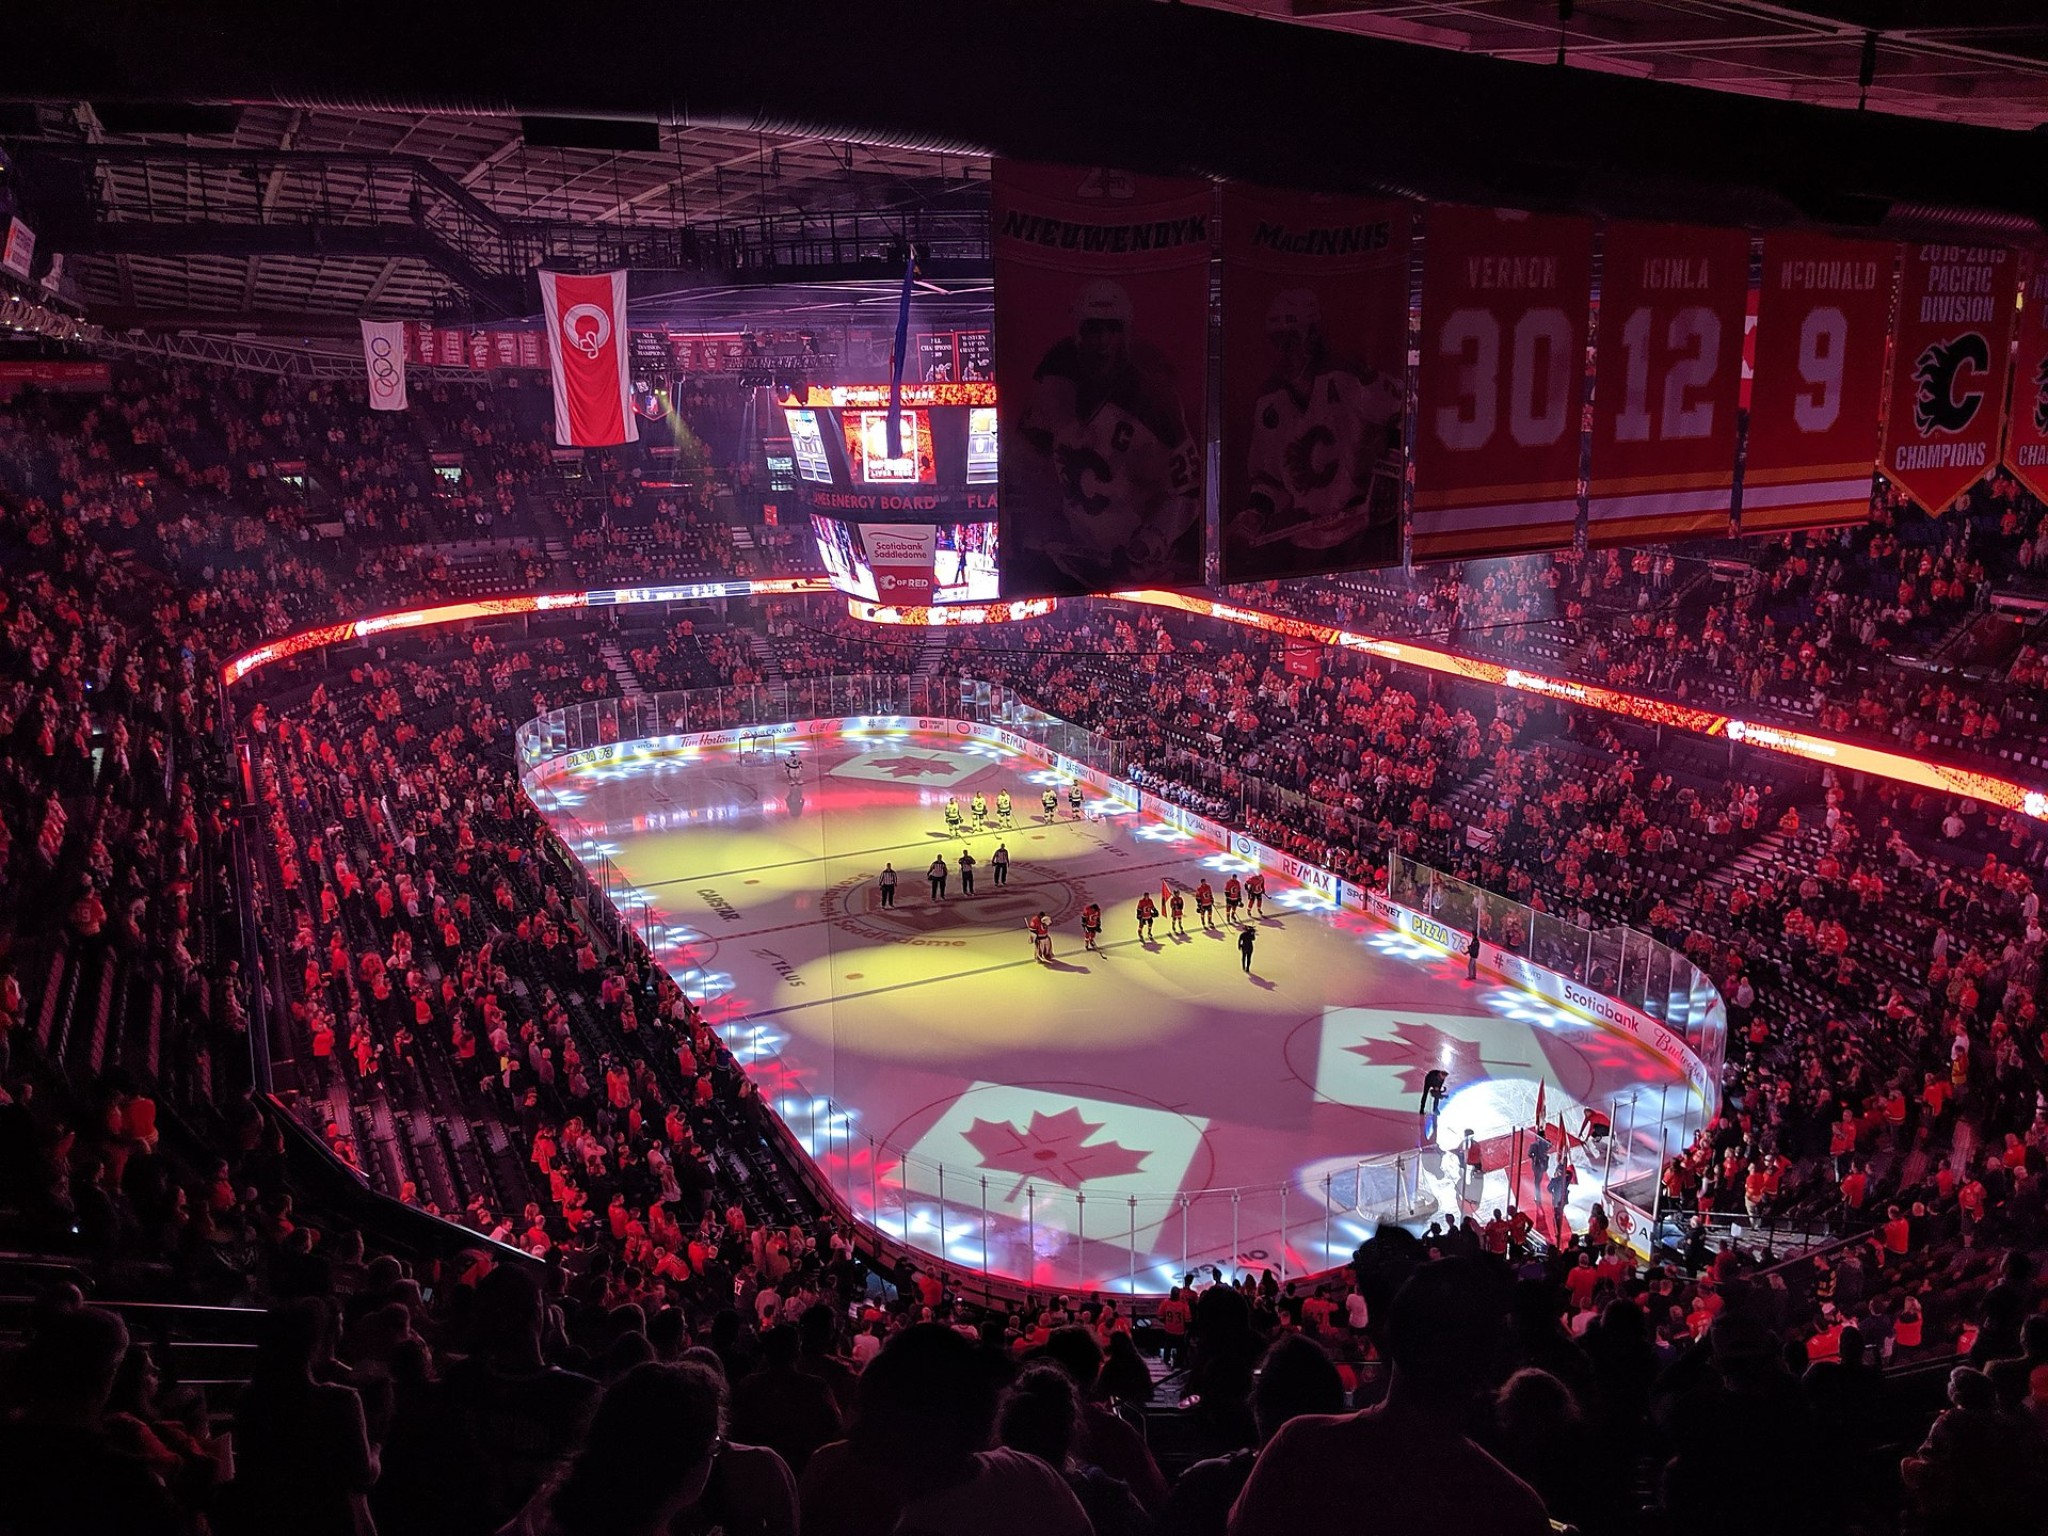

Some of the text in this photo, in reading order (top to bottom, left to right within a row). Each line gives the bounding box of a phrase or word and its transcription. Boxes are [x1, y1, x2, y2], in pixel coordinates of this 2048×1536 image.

[1003, 209, 1206, 254] NIEUWENDYK
[1468, 257, 1555, 289] VERNON
[1642, 258, 1709, 289] IGINLA
[1926, 266, 1992, 293] PACIFIC
[1919, 296, 1994, 323] DIVISION
[1435, 308, 1571, 452] 30
[1614, 308, 1721, 442] 12
[1793, 307, 1847, 433] 9
[1895, 442, 1986, 471] CHAMPIONS
[831, 494, 875, 509] ENERGY
[880, 496, 936, 510] BOARD
[966, 494, 997, 508] FLA
[873, 551, 927, 559] Saddledome
[875, 541, 923, 550] Scotiabank
[907, 577, 928, 588] RED
[680, 733, 736, 748] Tim Hortons
[765, 726, 797, 736] CANADA
[1000, 731, 1029, 753] RE/MAX
[566, 750, 596, 768] PIZZA
[598, 746, 613, 760] 73
[1281, 857, 1330, 892] RE/MAX
[1346, 887, 1403, 919] SPORTSNET
[1411, 914, 1470, 954] PIZZA 73
[770, 958, 806, 988] TELUS
[1563, 984, 1640, 1034] Scotiabank
[1653, 1027, 1705, 1085] Budweiser
